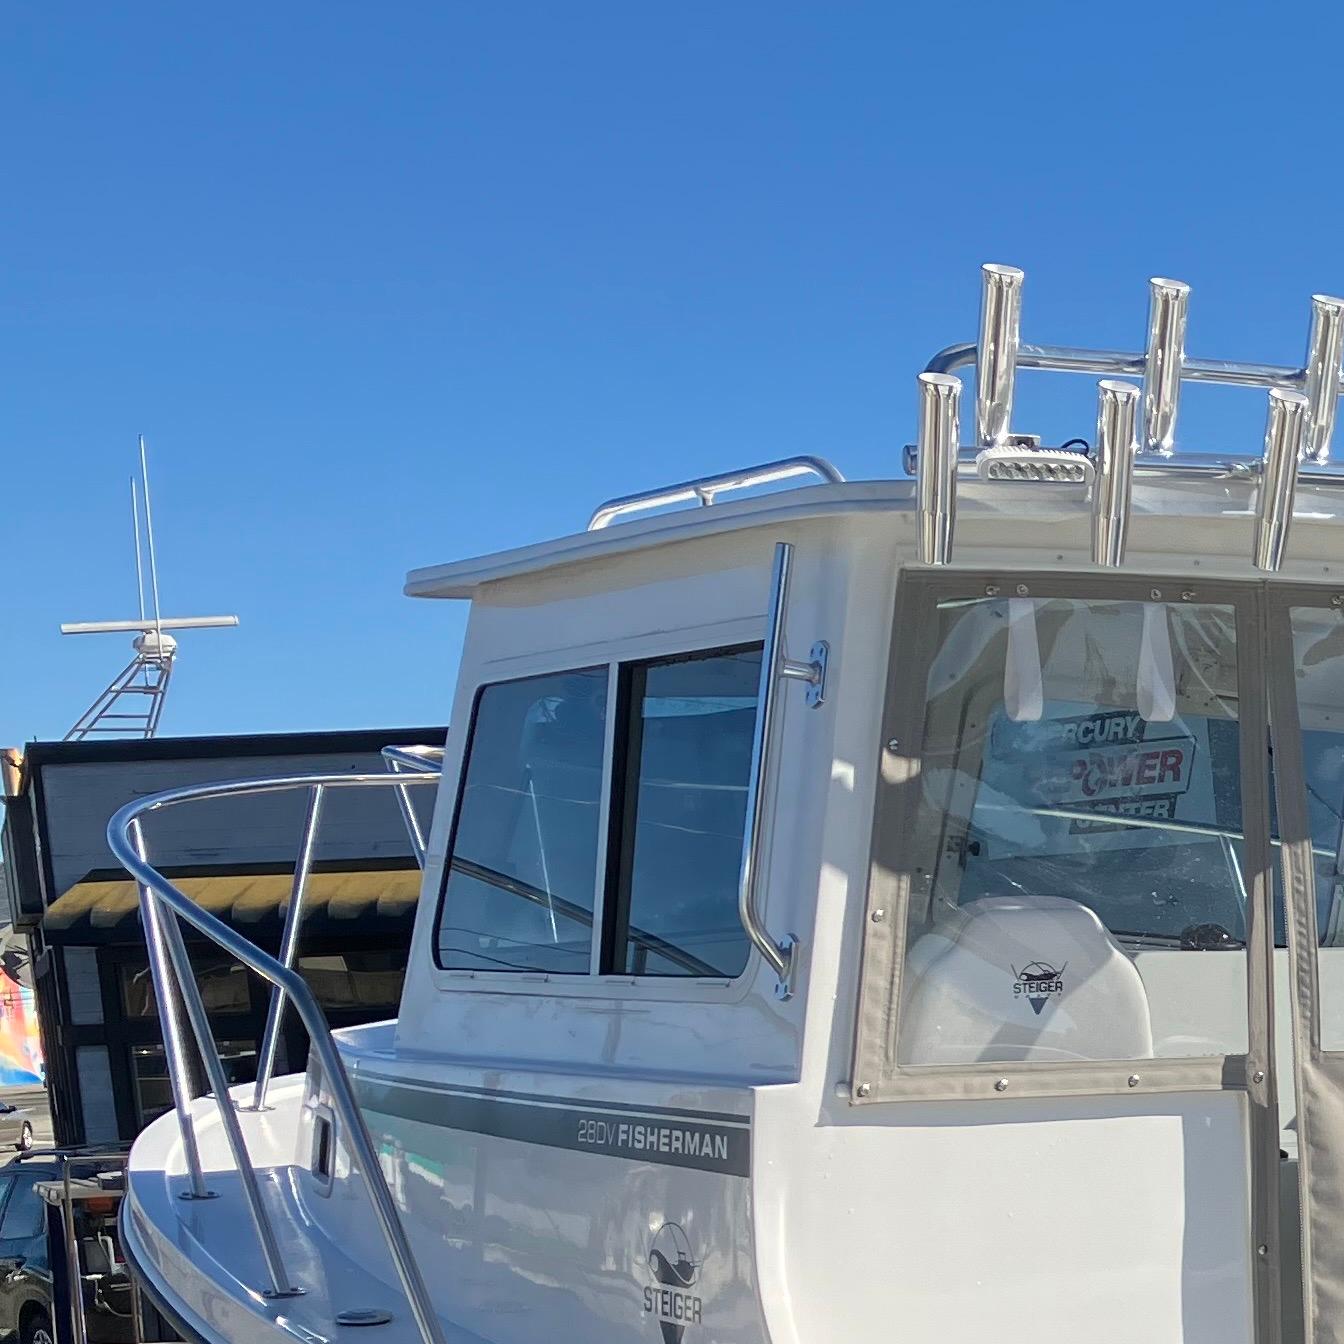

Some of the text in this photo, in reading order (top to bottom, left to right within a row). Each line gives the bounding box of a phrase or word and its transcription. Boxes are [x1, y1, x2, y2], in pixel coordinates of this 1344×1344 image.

[1060, 715, 1142, 745] RCURY
[1013, 980, 1063, 994] STEIGER
[578, 1119, 728, 1160] 28DV FISHERMAN
[643, 1285, 703, 1325] STEIGER
